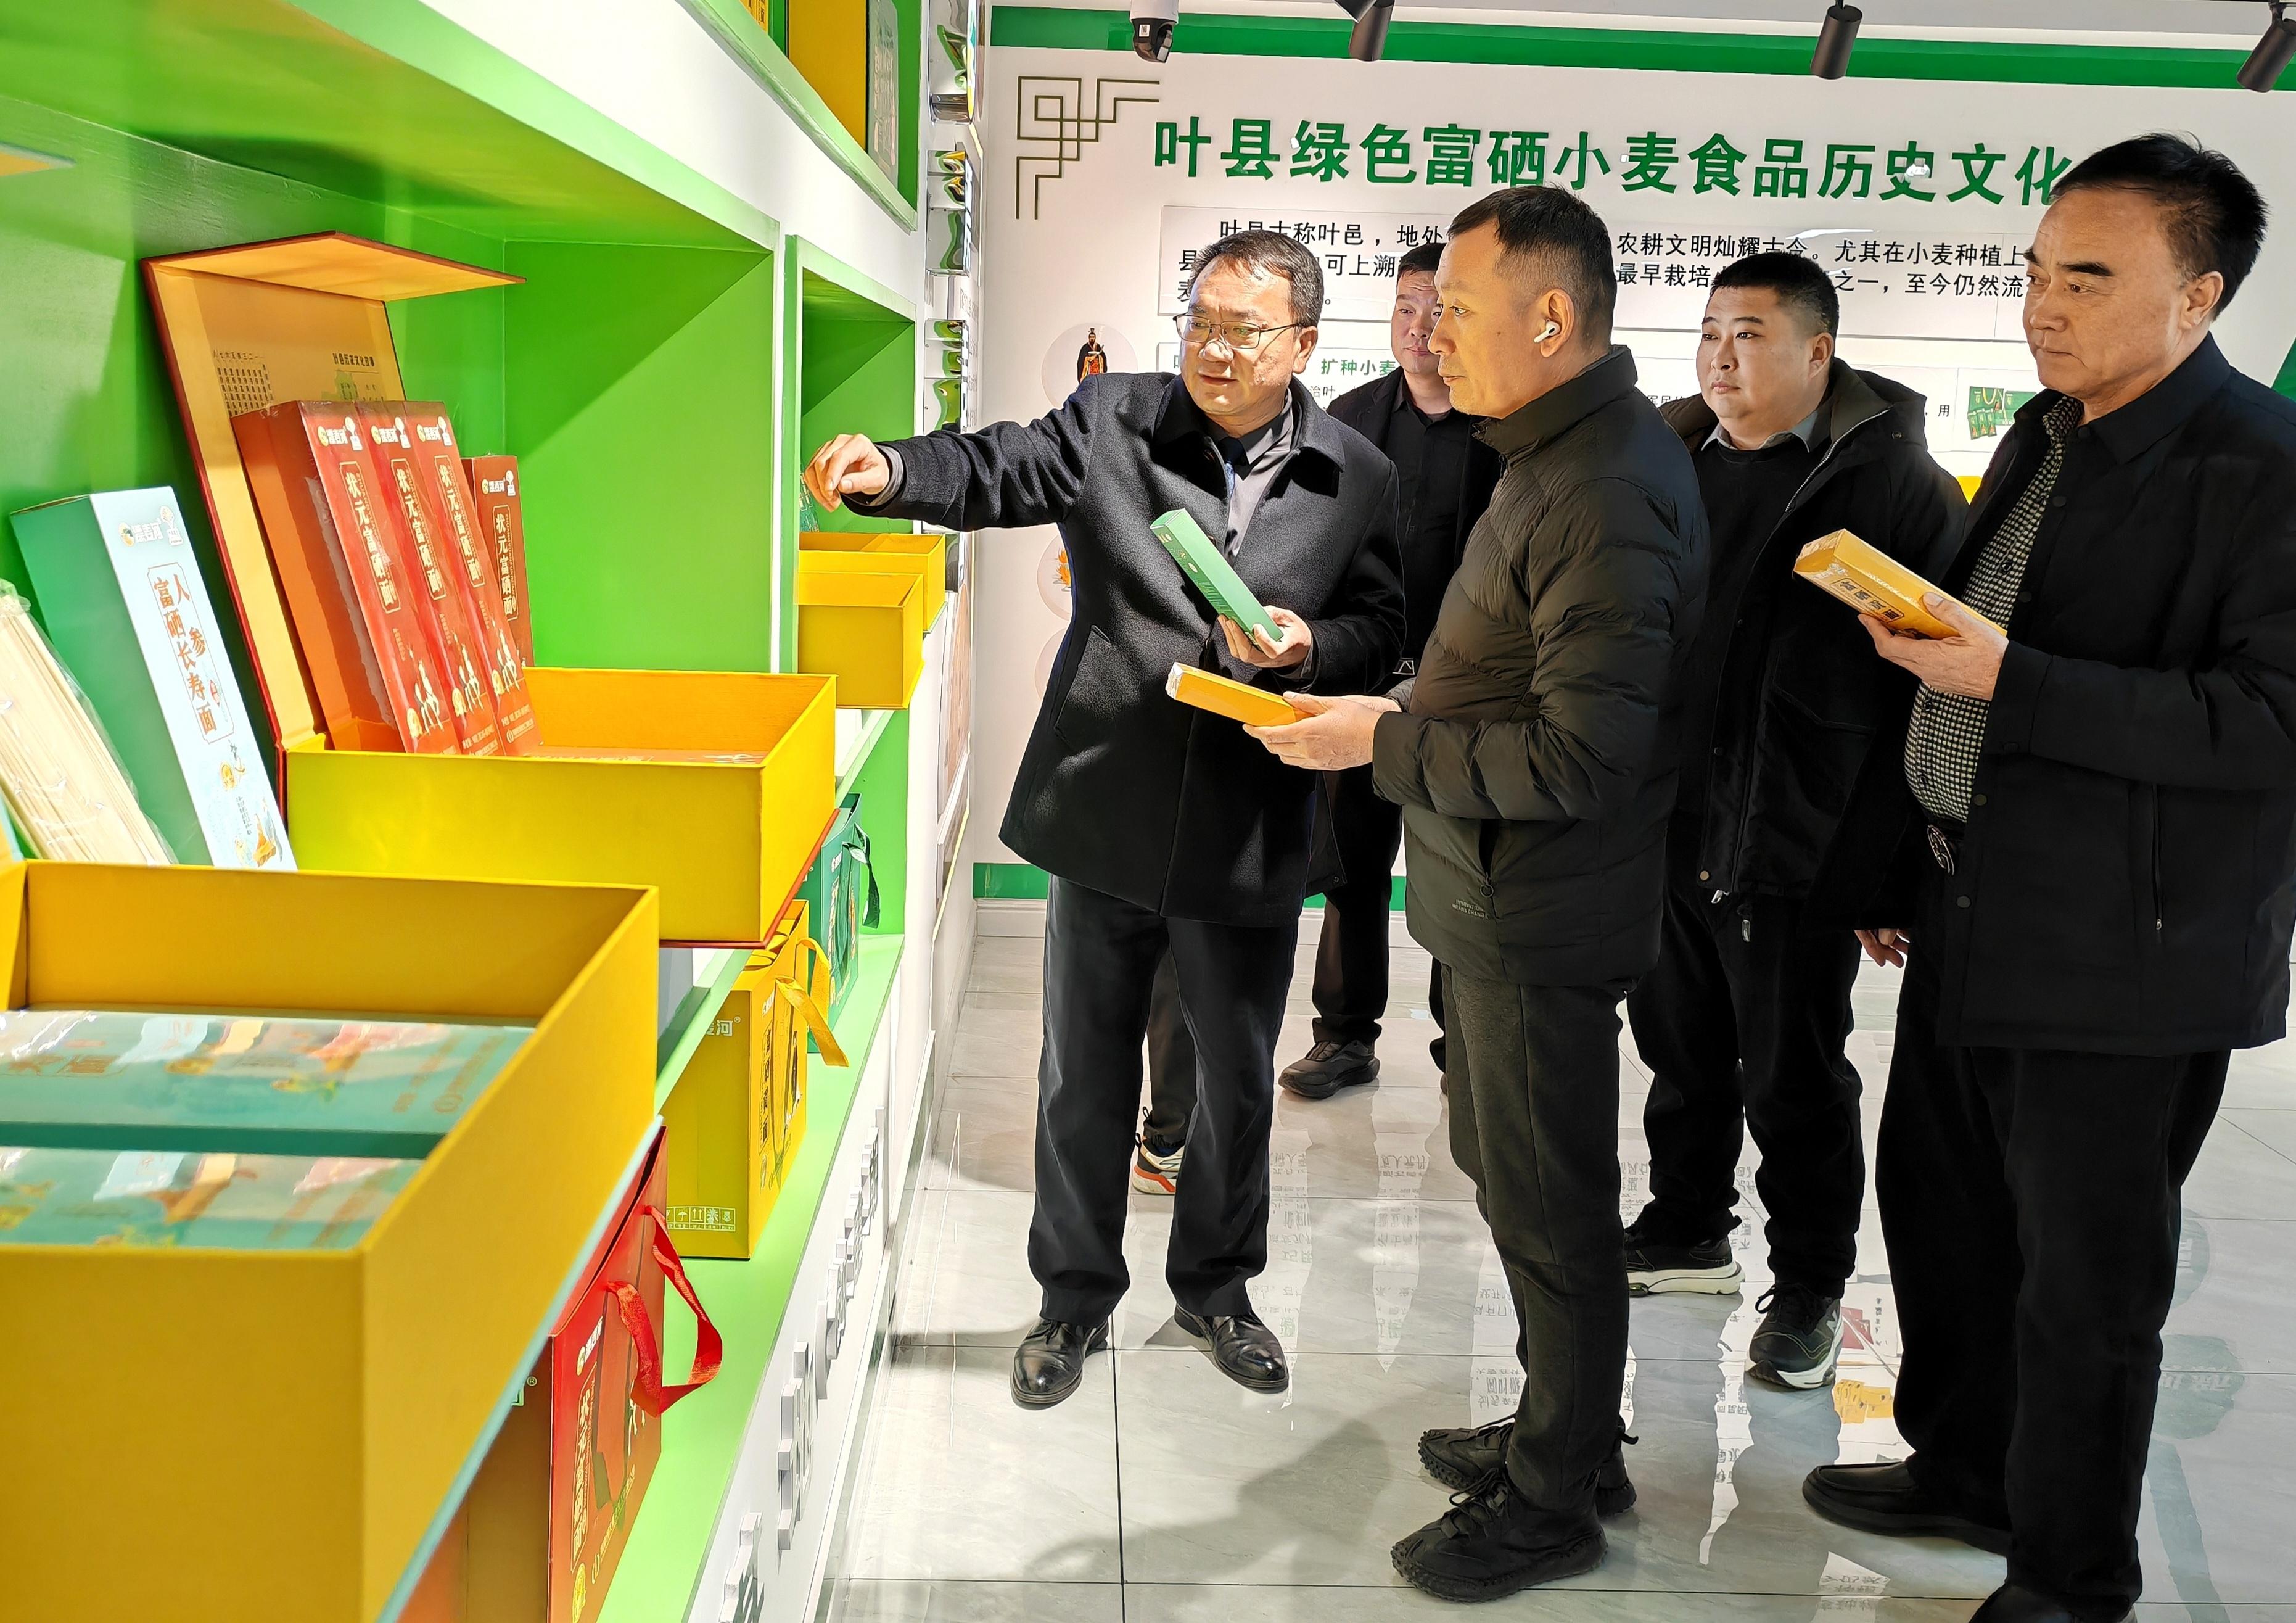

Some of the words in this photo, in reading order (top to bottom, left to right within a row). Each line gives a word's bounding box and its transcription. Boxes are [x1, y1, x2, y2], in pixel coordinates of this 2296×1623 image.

[1154, 116, 2073, 207] 叶县绿色富硒小麦食品历史文化
[345, 471, 393, 606] 状元富硒面
[396, 468, 442, 593] 状元富硒面
[440, 465, 482, 580] 状元富硒面
[495, 513, 514, 616] 状元富硒面
[153, 577, 217, 735] 富硒长寿面
[173, 573, 207, 658] 人参
